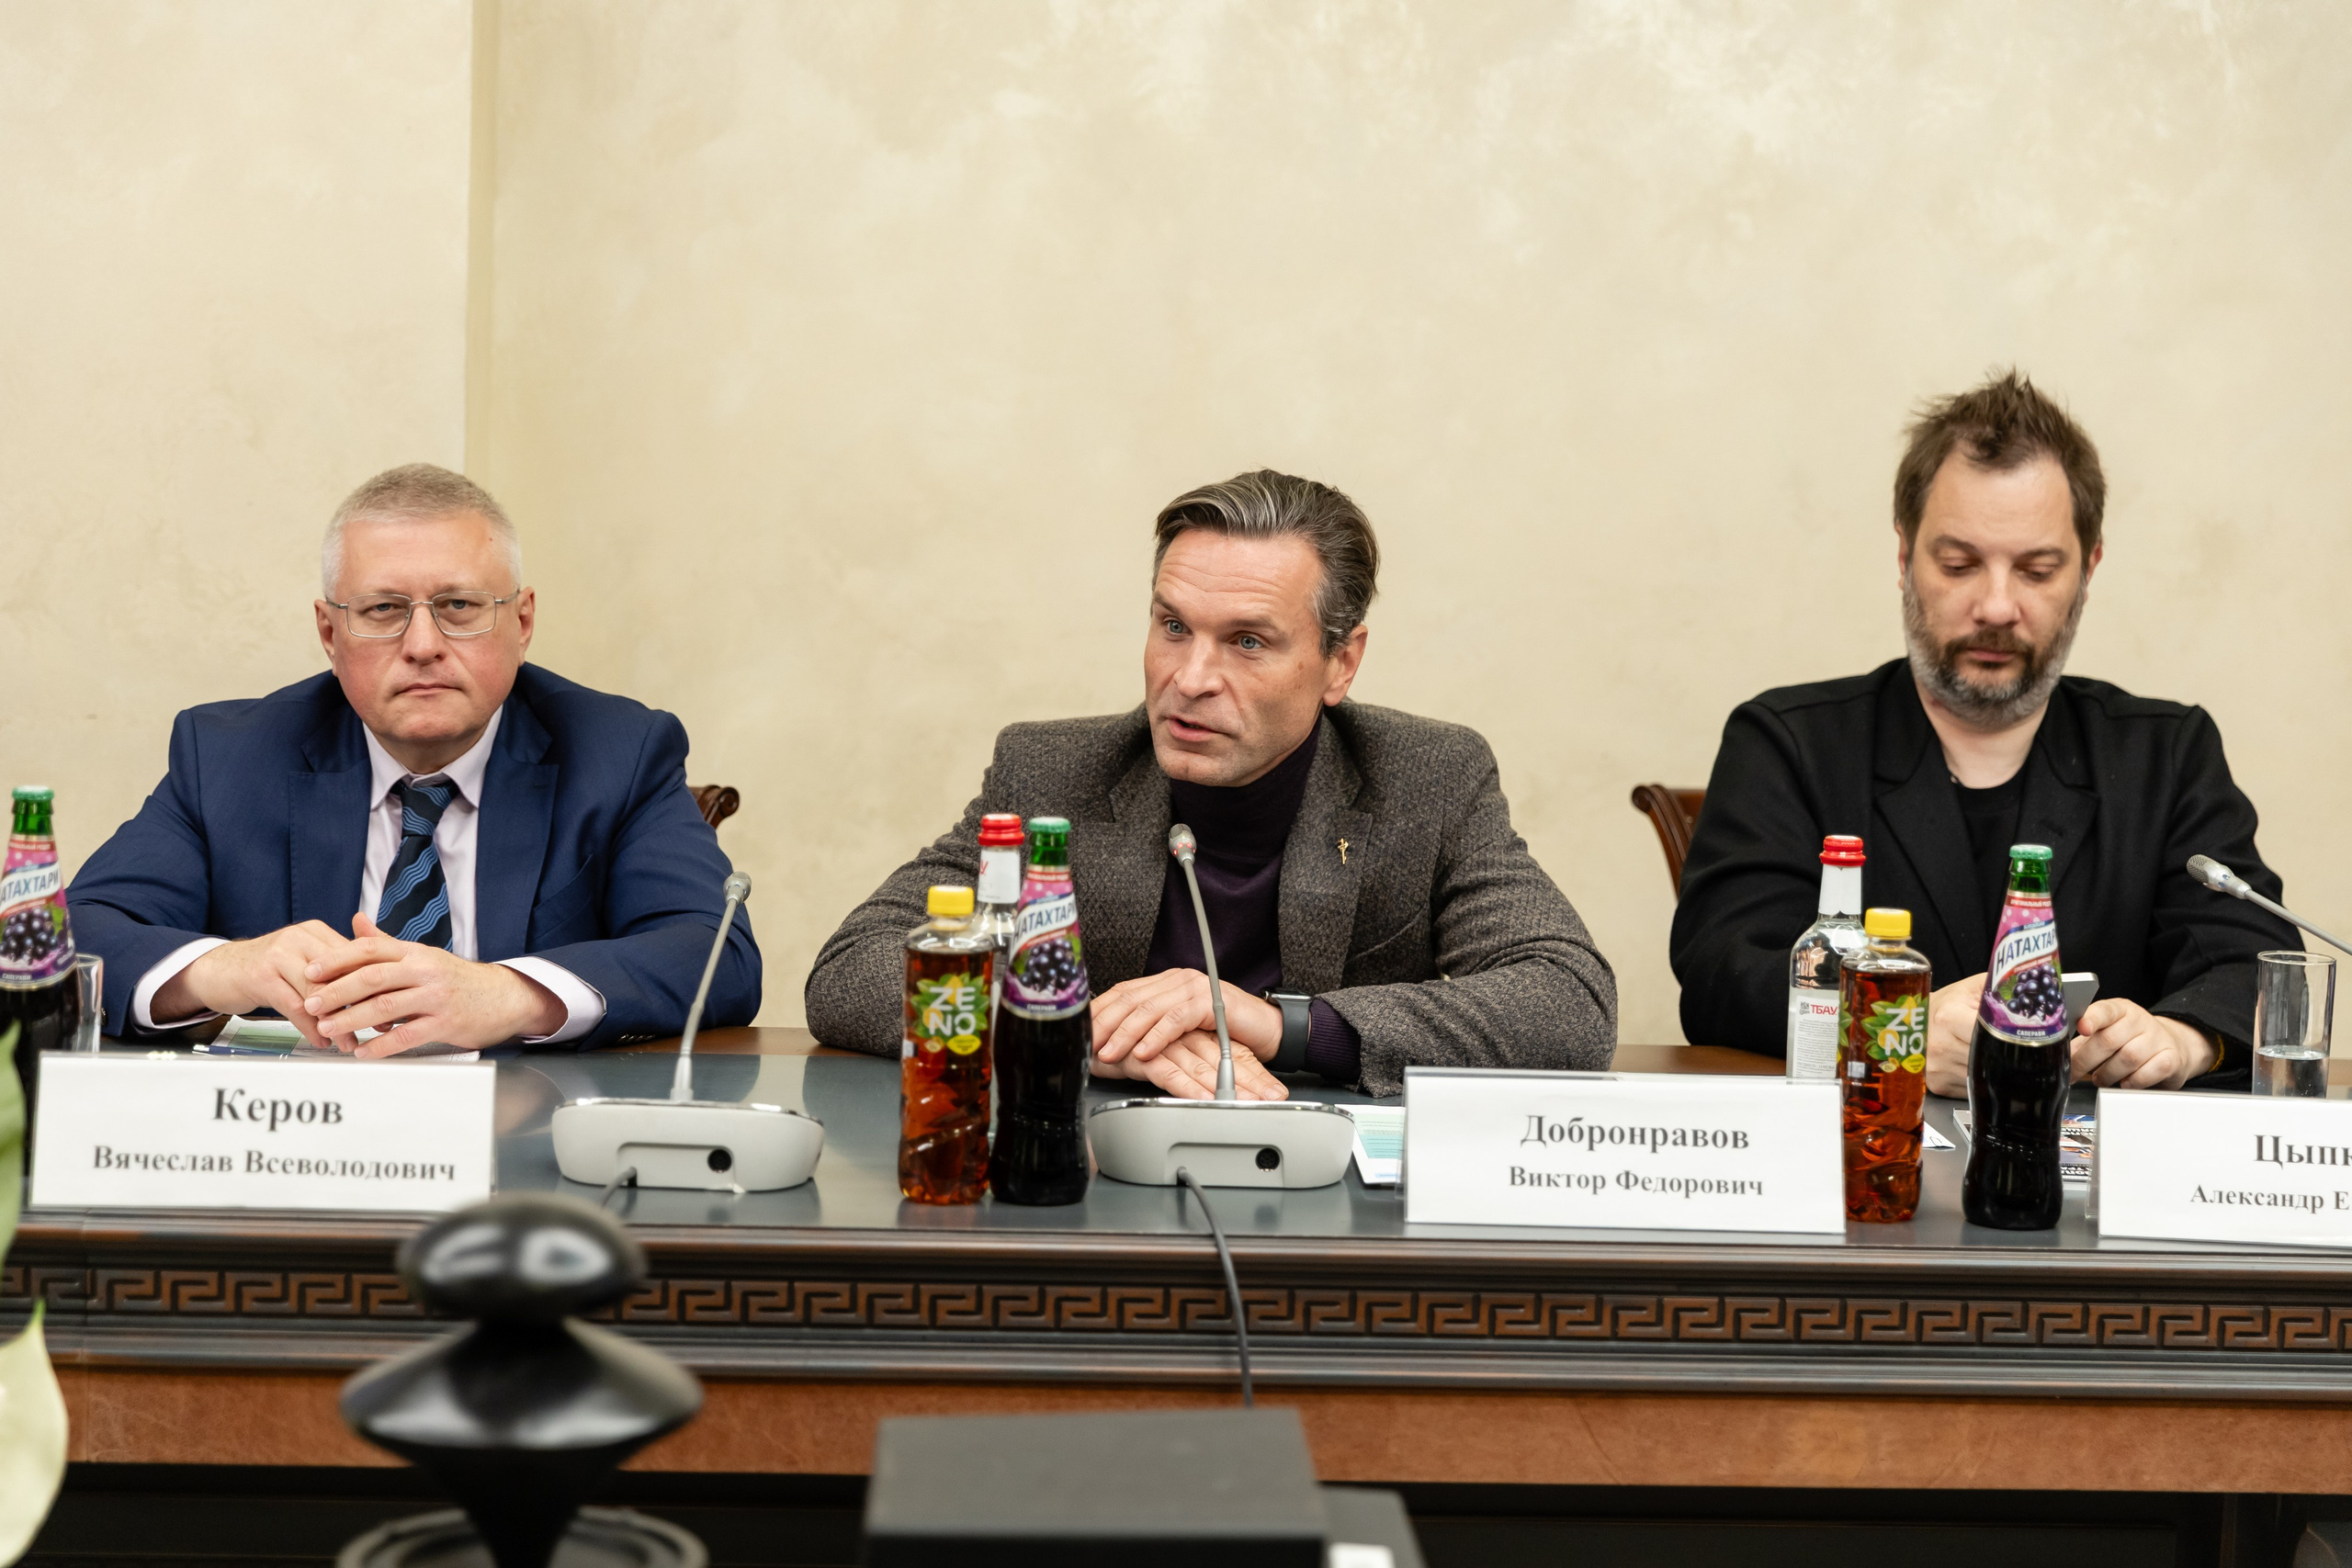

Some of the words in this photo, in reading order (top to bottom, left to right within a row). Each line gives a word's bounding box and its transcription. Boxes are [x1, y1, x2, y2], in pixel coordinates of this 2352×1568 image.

[929, 987, 976, 1010] ZE
[928, 1011, 977, 1036] NO
[1885, 1007, 1925, 1032] ZE
[1884, 1032, 1925, 1056] NO
[213, 1088, 344, 1132] Керов
[1521, 1114, 1750, 1154] Добронравов
[93, 1145, 233, 1171] Вячеслав
[244, 1150, 456, 1180] Всеволодович
[1509, 1167, 1607, 1195] Виктор
[1614, 1169, 1763, 1199] Федорович
[2190, 1184, 2324, 1214] Александр
